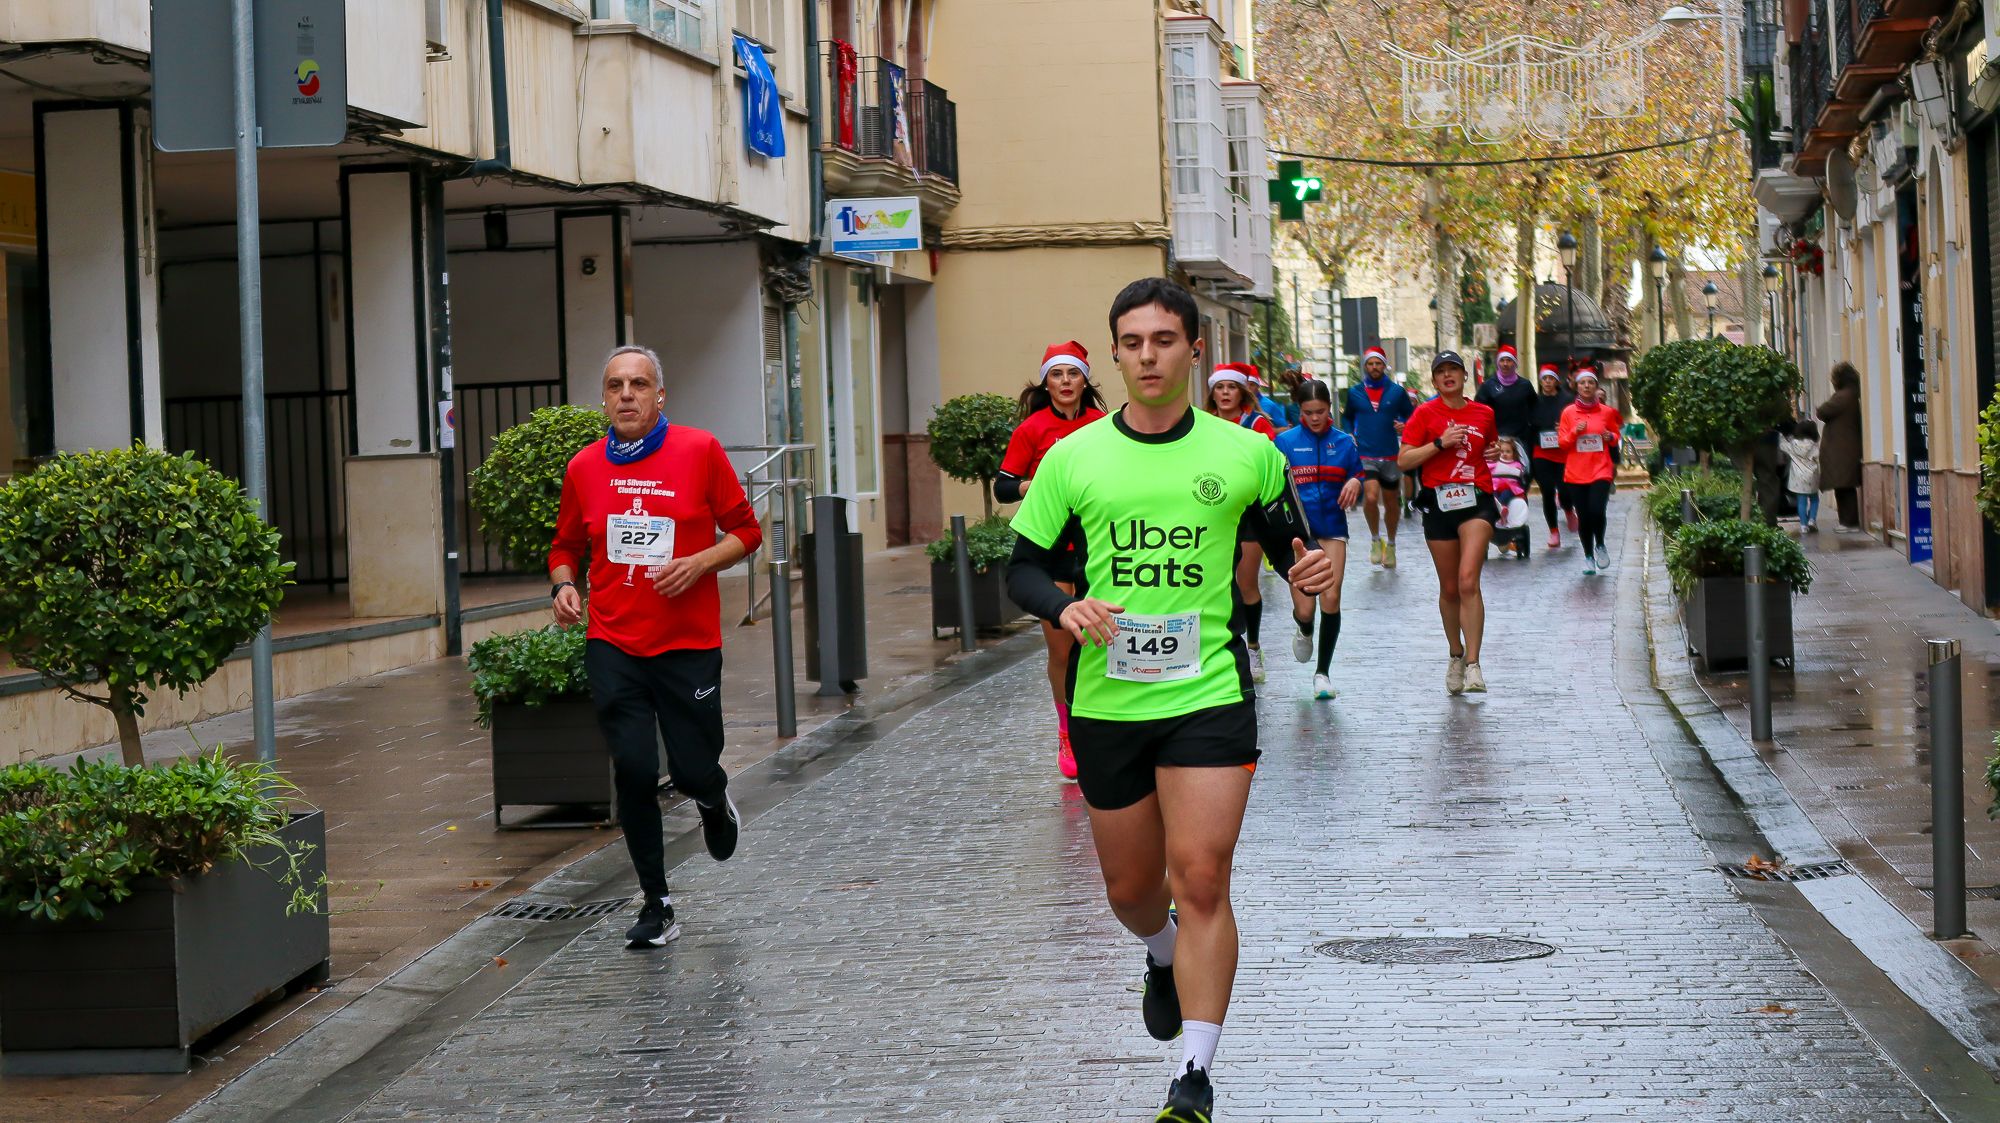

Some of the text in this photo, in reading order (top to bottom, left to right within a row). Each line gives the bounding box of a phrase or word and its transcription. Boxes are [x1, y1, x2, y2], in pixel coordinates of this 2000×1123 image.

[582, 258, 596, 275] 8
[614, 479, 627, 487] San
[617, 487, 676, 498] Ciudad de Lucena
[1445, 487, 1467, 500] 441
[620, 531, 660, 546] 227
[1109, 519, 1208, 552] Uber
[1110, 556, 1204, 588] Eats
[1126, 636, 1179, 656] 149
